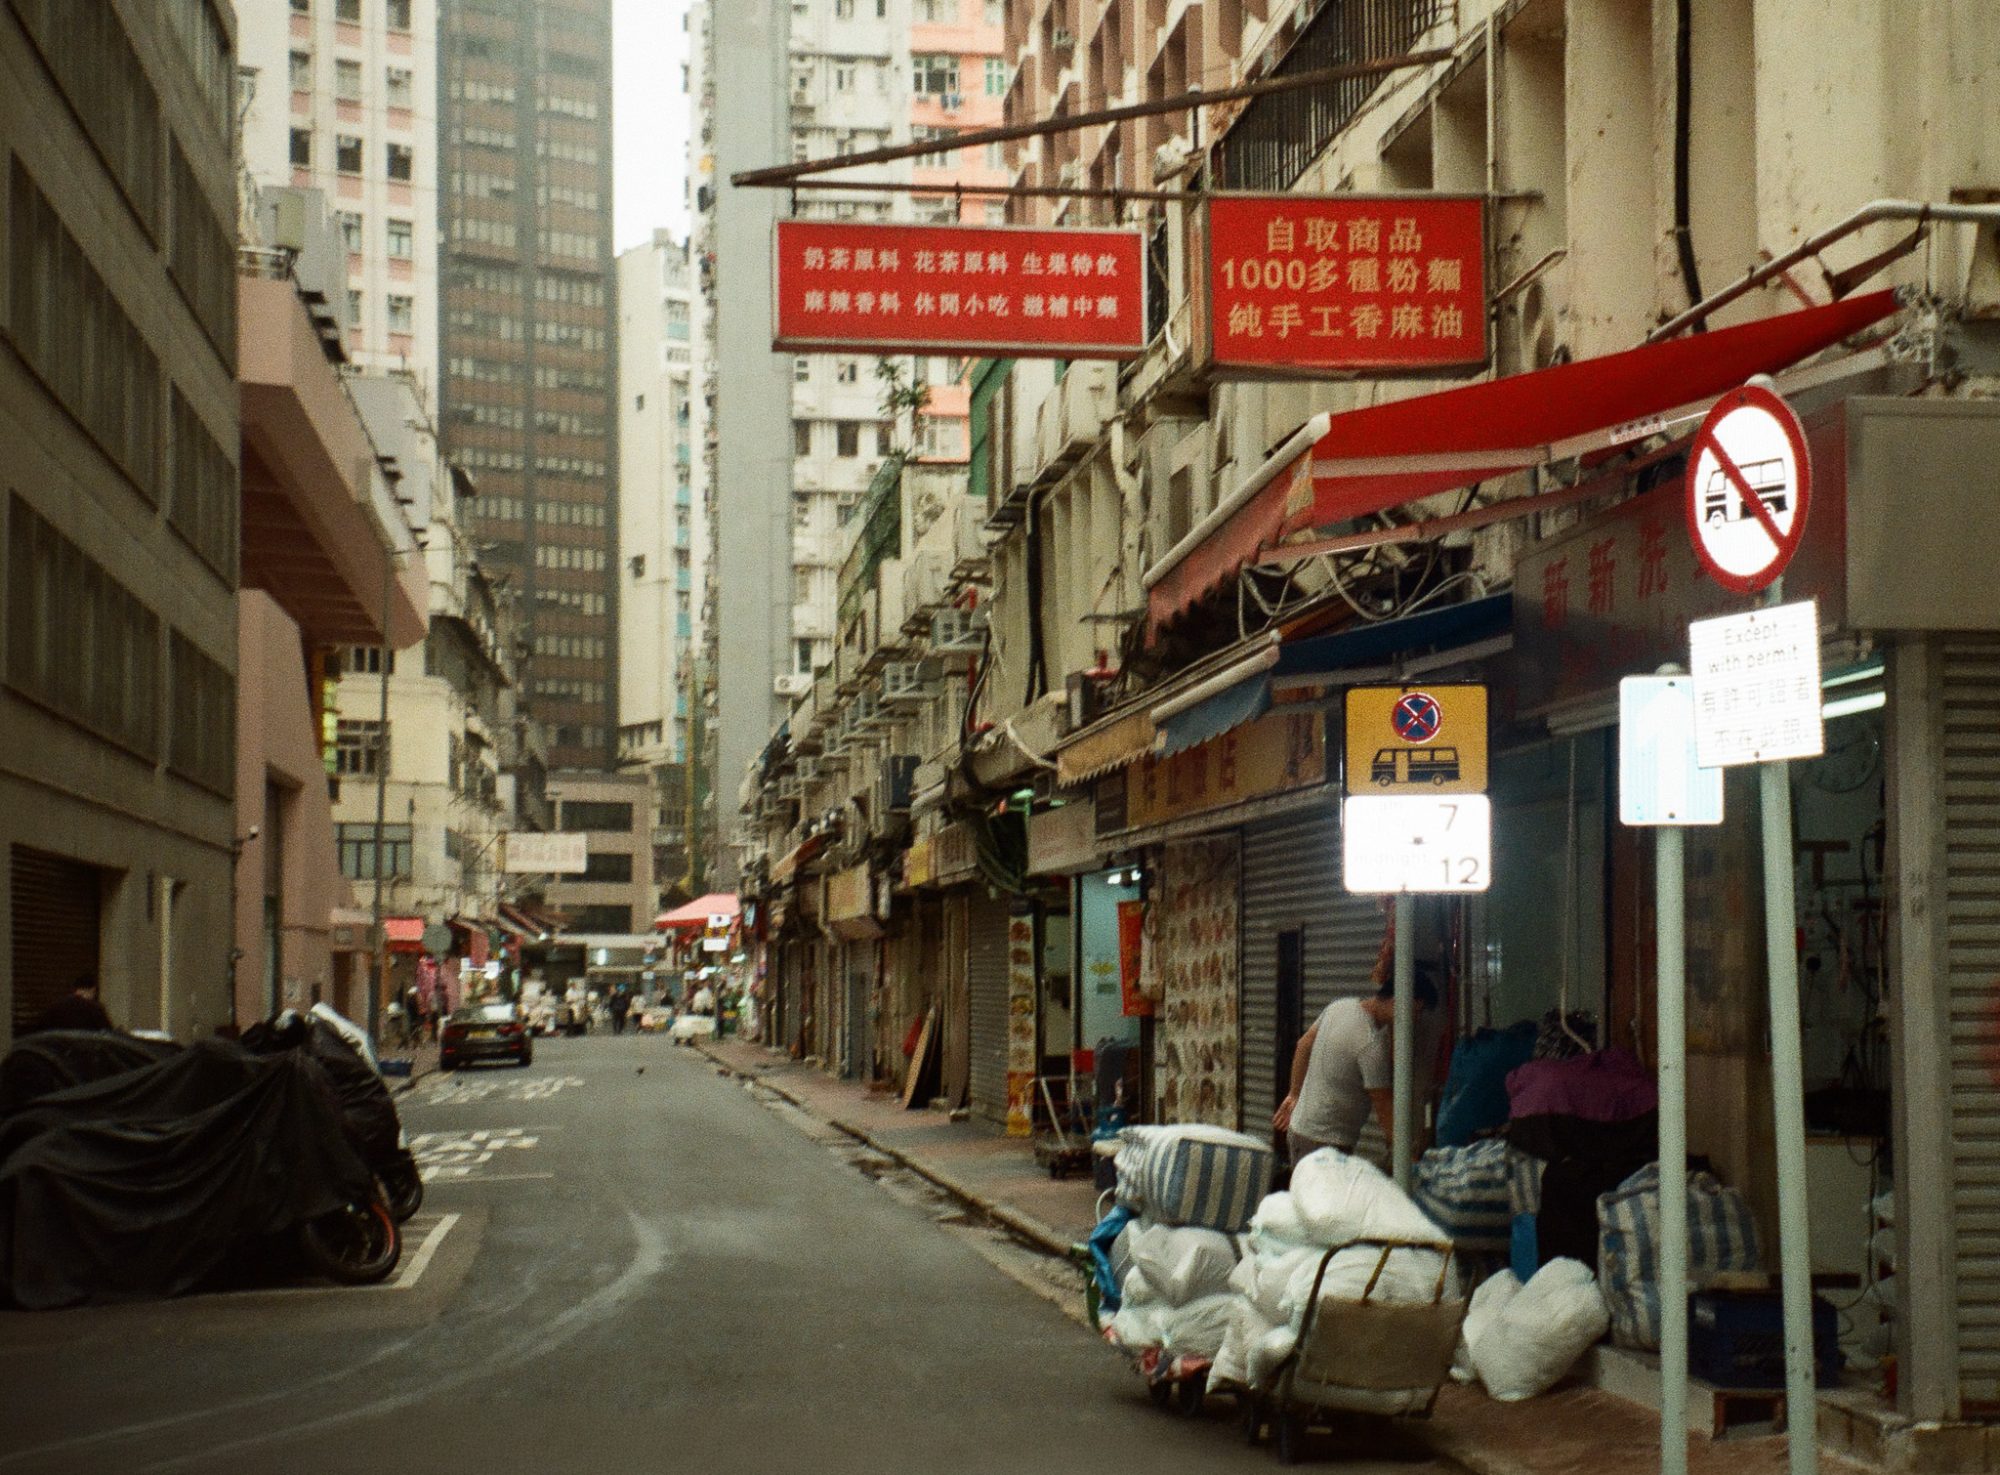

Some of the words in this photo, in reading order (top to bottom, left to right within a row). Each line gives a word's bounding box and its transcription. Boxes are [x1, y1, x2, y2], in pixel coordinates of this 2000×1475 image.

[1267, 217, 1422, 253] 自取商品
[1229, 302, 1463, 339] 純手工香麻油
[1724, 622, 1778, 646] Except
[1438, 803, 1459, 832] 7
[1441, 856, 1479, 885] 12
